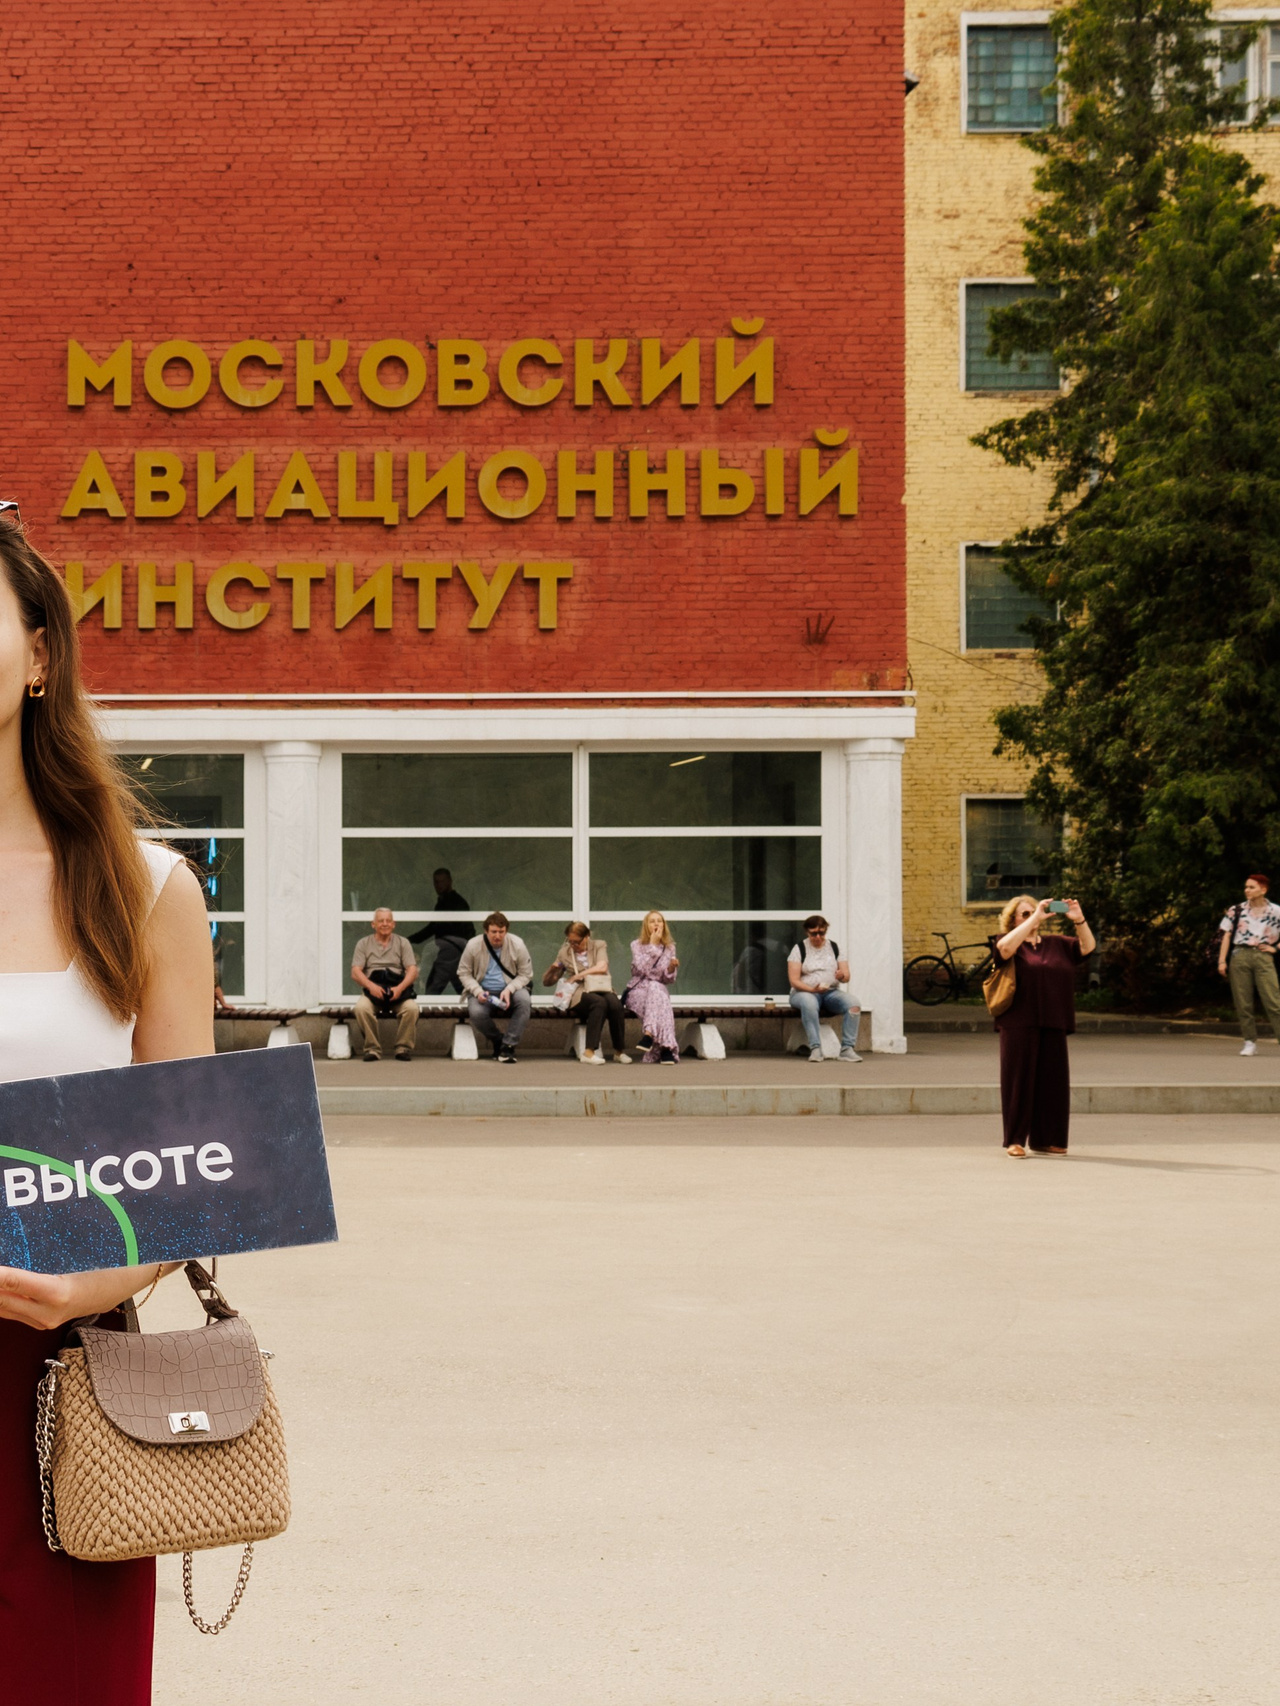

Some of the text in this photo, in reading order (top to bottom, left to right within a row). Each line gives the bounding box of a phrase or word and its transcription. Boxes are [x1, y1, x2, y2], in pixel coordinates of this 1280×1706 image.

[66, 317, 775, 408] МОСКОВСКИЙ
[61, 428, 860, 525] АВИАЦИОННЫЙ
[66, 561, 574, 630] ИНСТИТУТ
[3, 1141, 235, 1207] высоте
